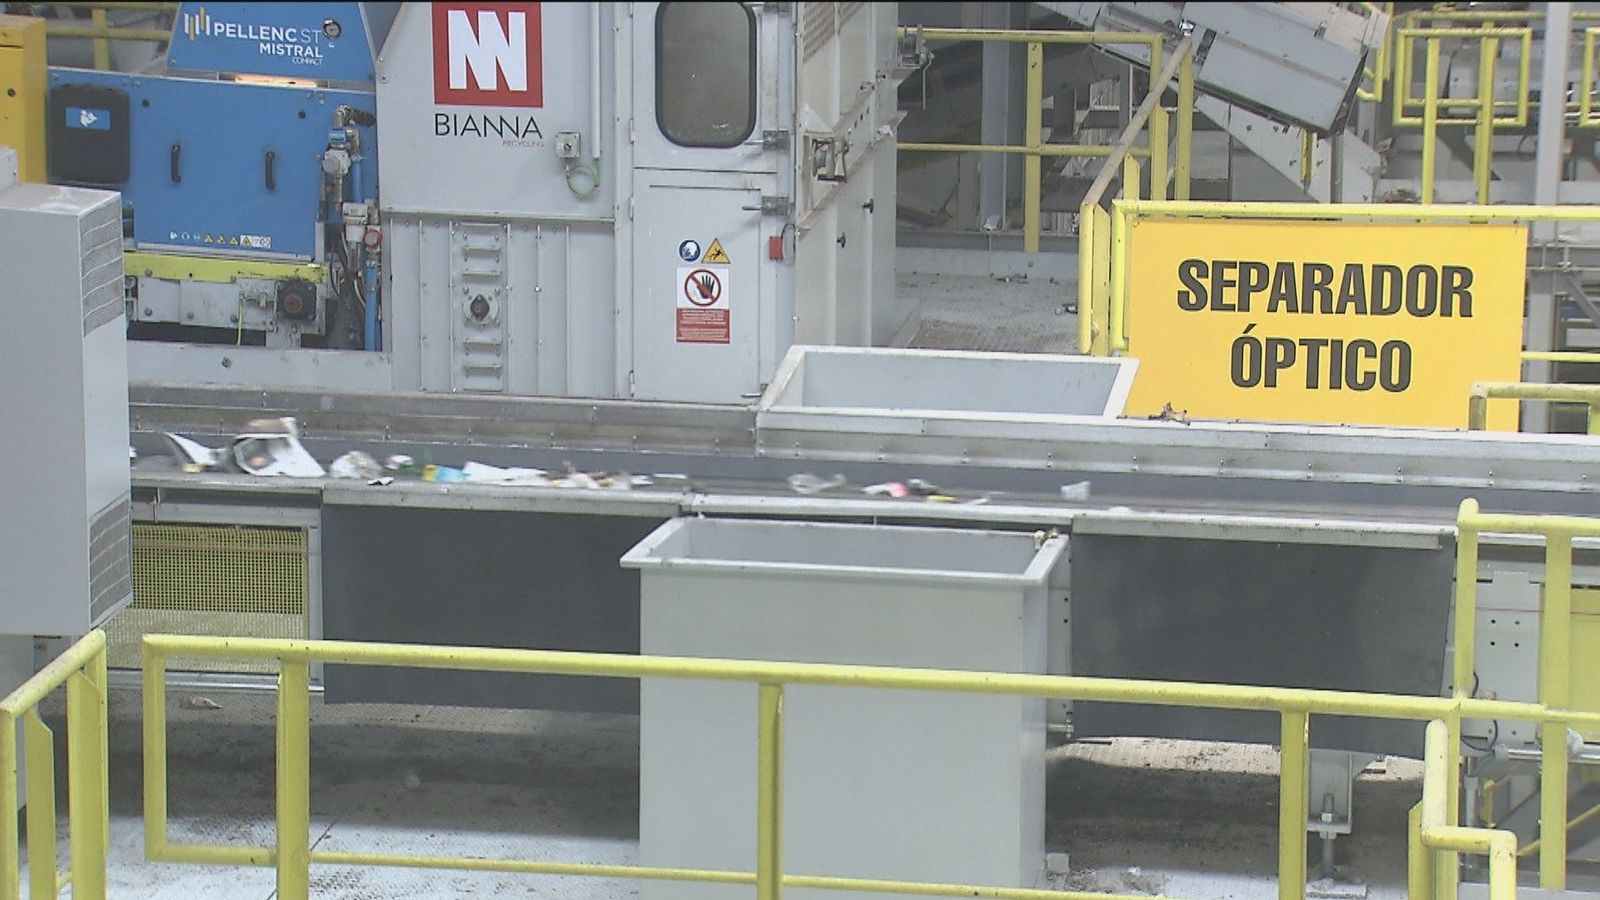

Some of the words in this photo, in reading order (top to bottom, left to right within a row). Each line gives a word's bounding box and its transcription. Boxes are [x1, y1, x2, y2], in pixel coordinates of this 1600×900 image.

[214, 22, 297, 43] PELLENC
[300, 29, 322, 44] ST
[259, 43, 323, 58] MISTRAL
[434, 113, 543, 139] BIANNA
[1177, 258, 1474, 318] SEPARADOR
[1230, 323, 1412, 393] ÓPTICO
